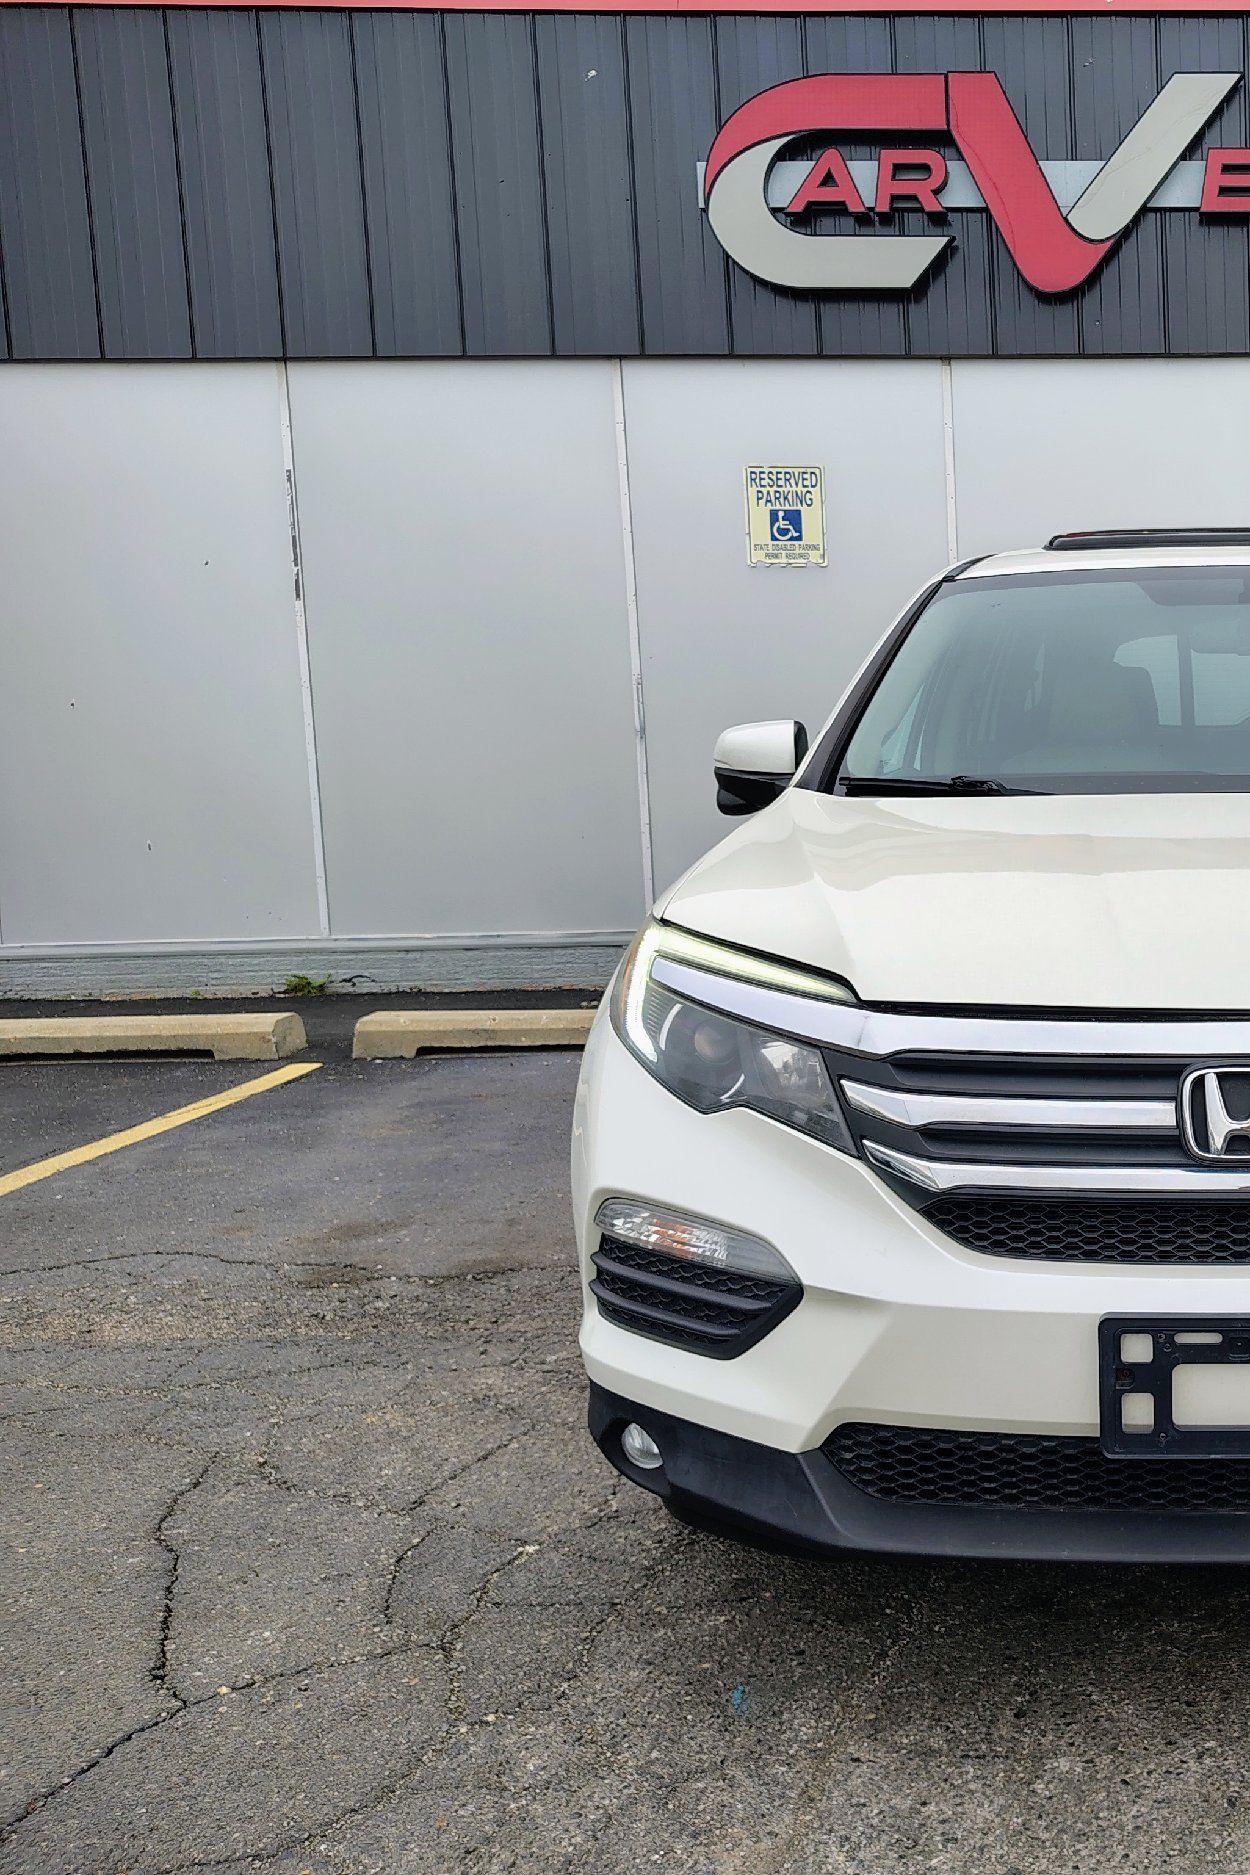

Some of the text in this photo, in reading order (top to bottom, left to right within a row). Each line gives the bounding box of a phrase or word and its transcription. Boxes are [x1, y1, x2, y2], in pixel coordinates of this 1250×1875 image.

[750, 471, 818, 488] RESERVED
[756, 490, 813, 507] PARKING
[765, 552, 783, 560] PERMIT
